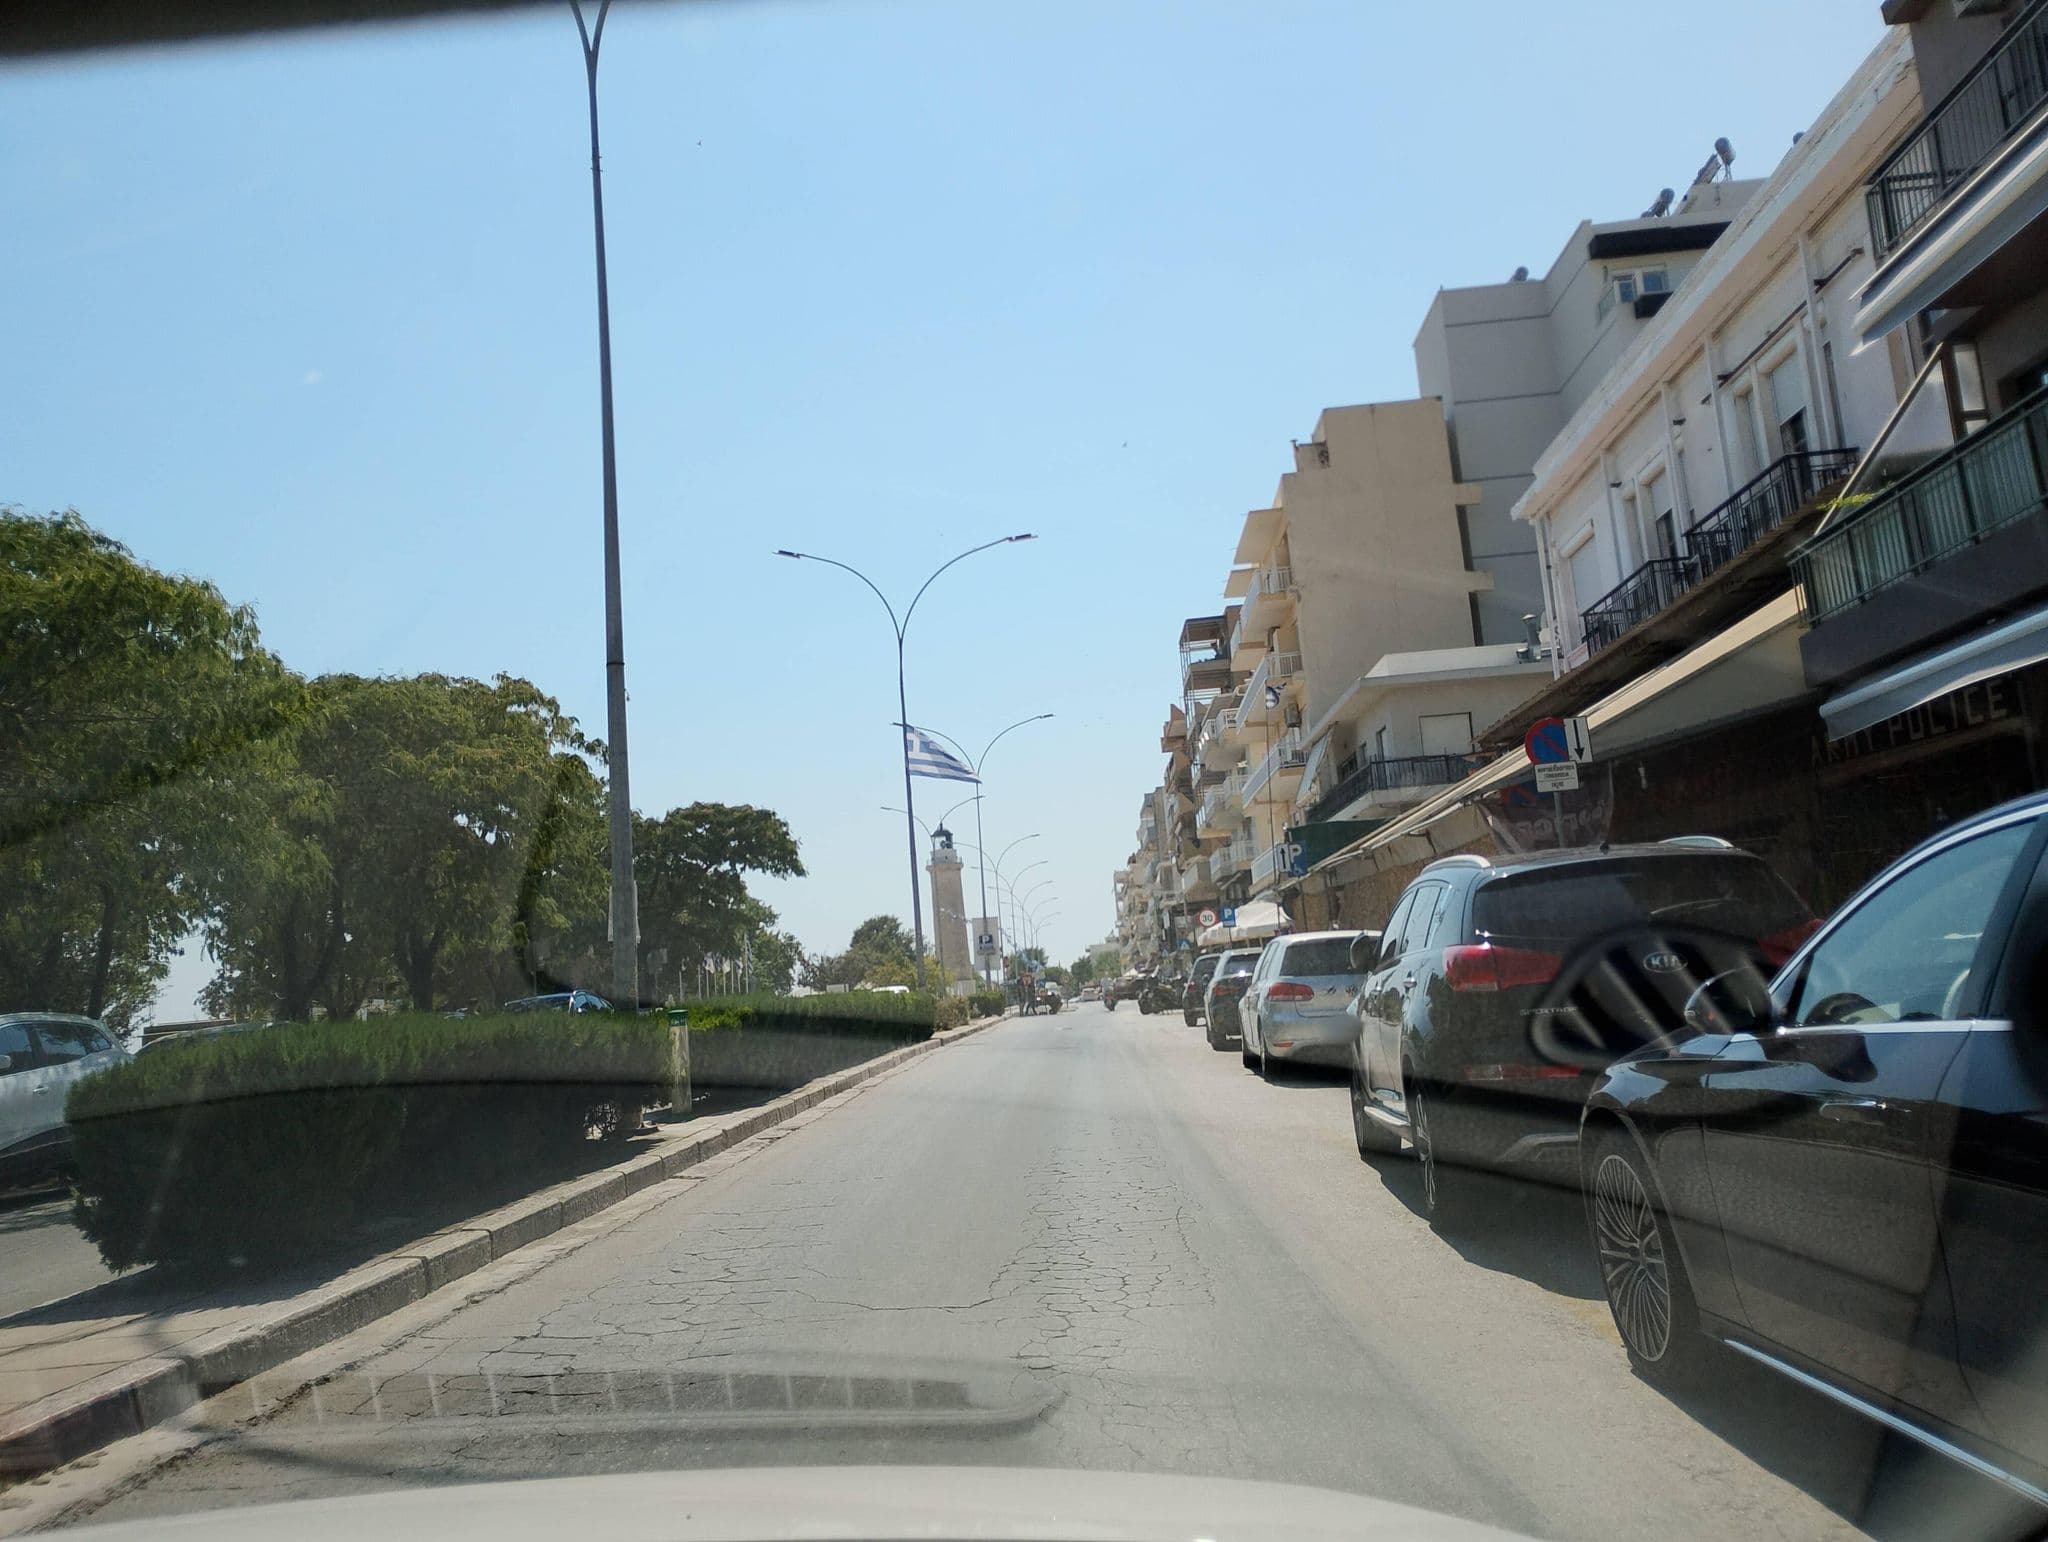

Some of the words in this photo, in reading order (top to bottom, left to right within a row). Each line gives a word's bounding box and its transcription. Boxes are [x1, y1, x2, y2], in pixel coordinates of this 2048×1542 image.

[1887, 680, 2009, 747] POLICE
[1289, 844, 1302, 863] P
[1202, 914, 1213, 923] 30
[1224, 908, 1233, 919] P
[982, 935, 990, 945] P
[1650, 953, 1683, 969] KIA
